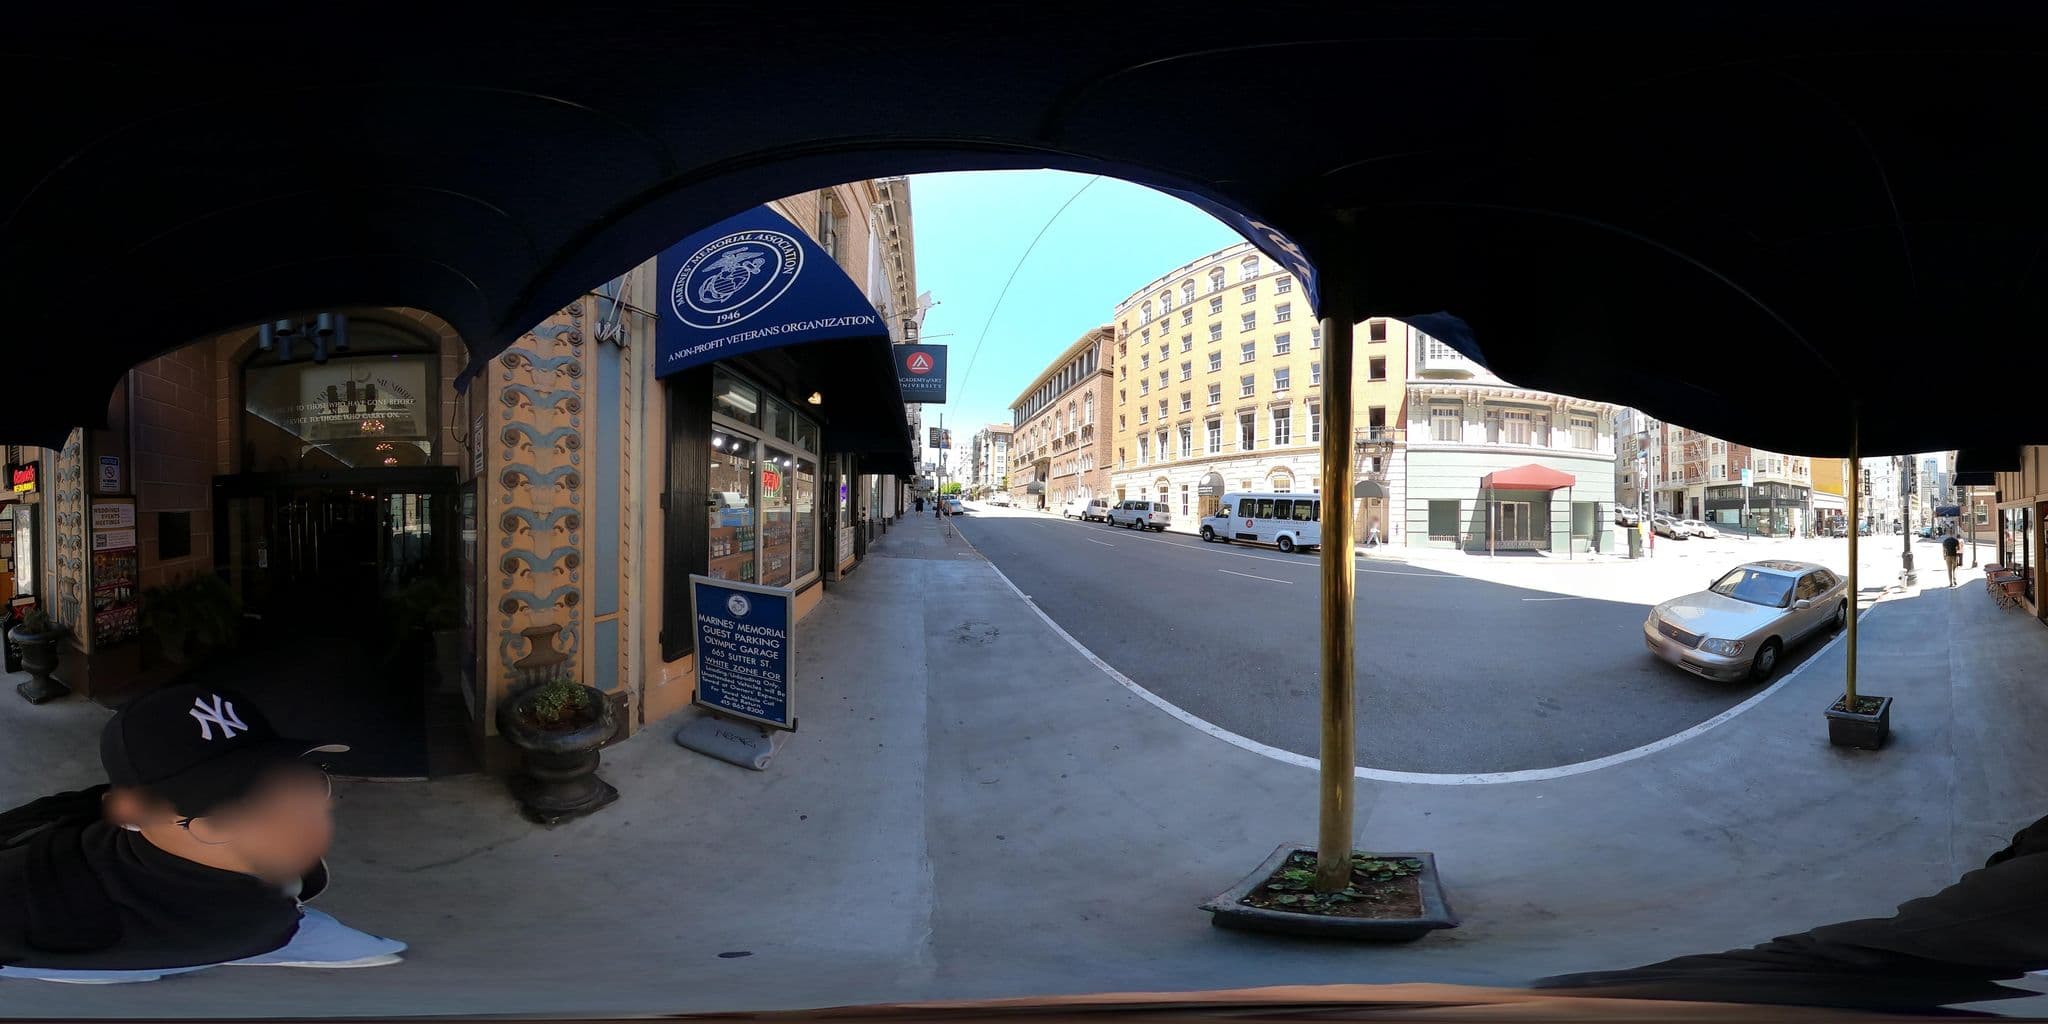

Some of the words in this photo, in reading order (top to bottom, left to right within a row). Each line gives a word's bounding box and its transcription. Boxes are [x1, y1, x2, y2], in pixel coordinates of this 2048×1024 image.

[676, 264, 693, 307] MARINES'
[691, 233, 753, 264] MEMORIAL
[754, 233, 797, 275] ASSOCIATION
[716, 310, 741, 324] 1946
[668, 354, 675, 362] A
[674, 338, 726, 361] NON-PROFIT
[726, 325, 780, 345] VETERANS
[781, 315, 875, 333] ORGANIZATION
[698, 613, 735, 629] MARINES'
[737, 623, 786, 639] MEMORIAL
[702, 625, 731, 639] GUEST
[734, 633, 780, 648] PARKING
[704, 635, 736, 651] OLYMPIC
[739, 645, 779, 660] GARAGE
[711, 648, 725, 658] 665
[728, 652, 757, 666] SUTTER
[704, 656, 729, 669] WHITE
[733, 664, 759, 675] ZONE
[762, 670, 781, 680] FOR
